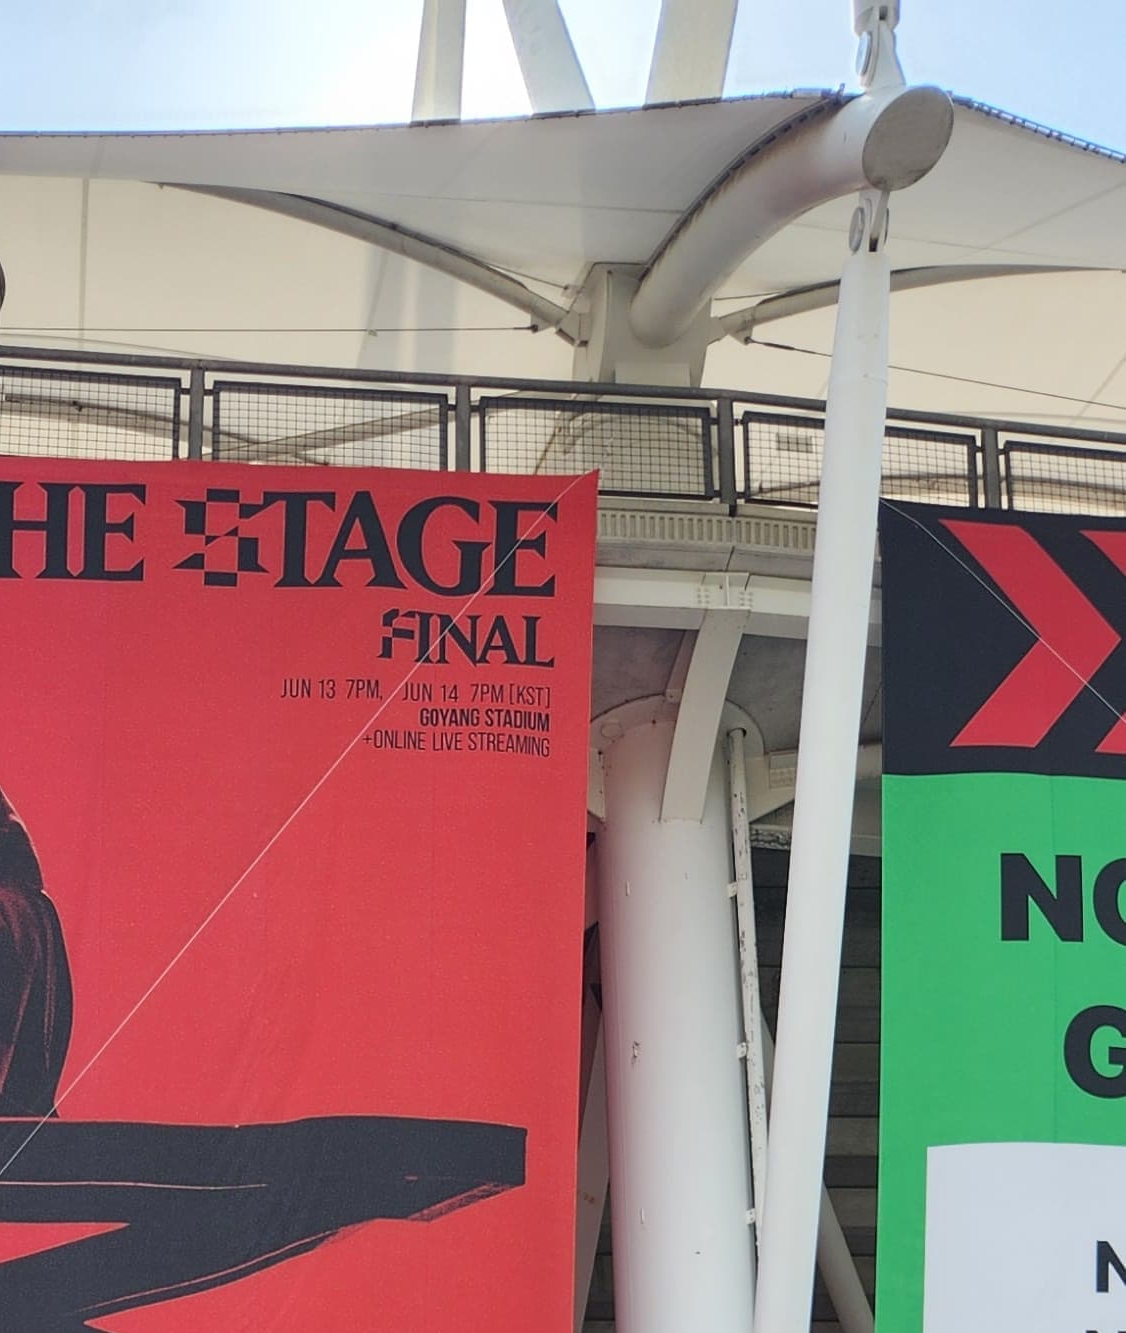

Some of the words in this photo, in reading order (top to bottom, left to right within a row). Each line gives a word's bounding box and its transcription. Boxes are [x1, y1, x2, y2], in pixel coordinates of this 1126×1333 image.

[173, 488, 558, 598] STAGE
[377, 608, 555, 668] FINAL
[281, 679, 311, 699] JUN
[318, 680, 336, 699] 13
[346, 679, 383, 701] 7PM,
[402, 683, 432, 702] JUN
[440, 684, 459, 702] 14
[471, 684, 504, 703] 7PM
[509, 685, 551, 708] [KST]
[420, 708, 480, 727] GOYANG
[485, 709, 550, 732] STADIUM
[362, 729, 426, 750] +ONLINE
[433, 732, 463, 751] LIVE
[468, 731, 550, 758] STREAMING
